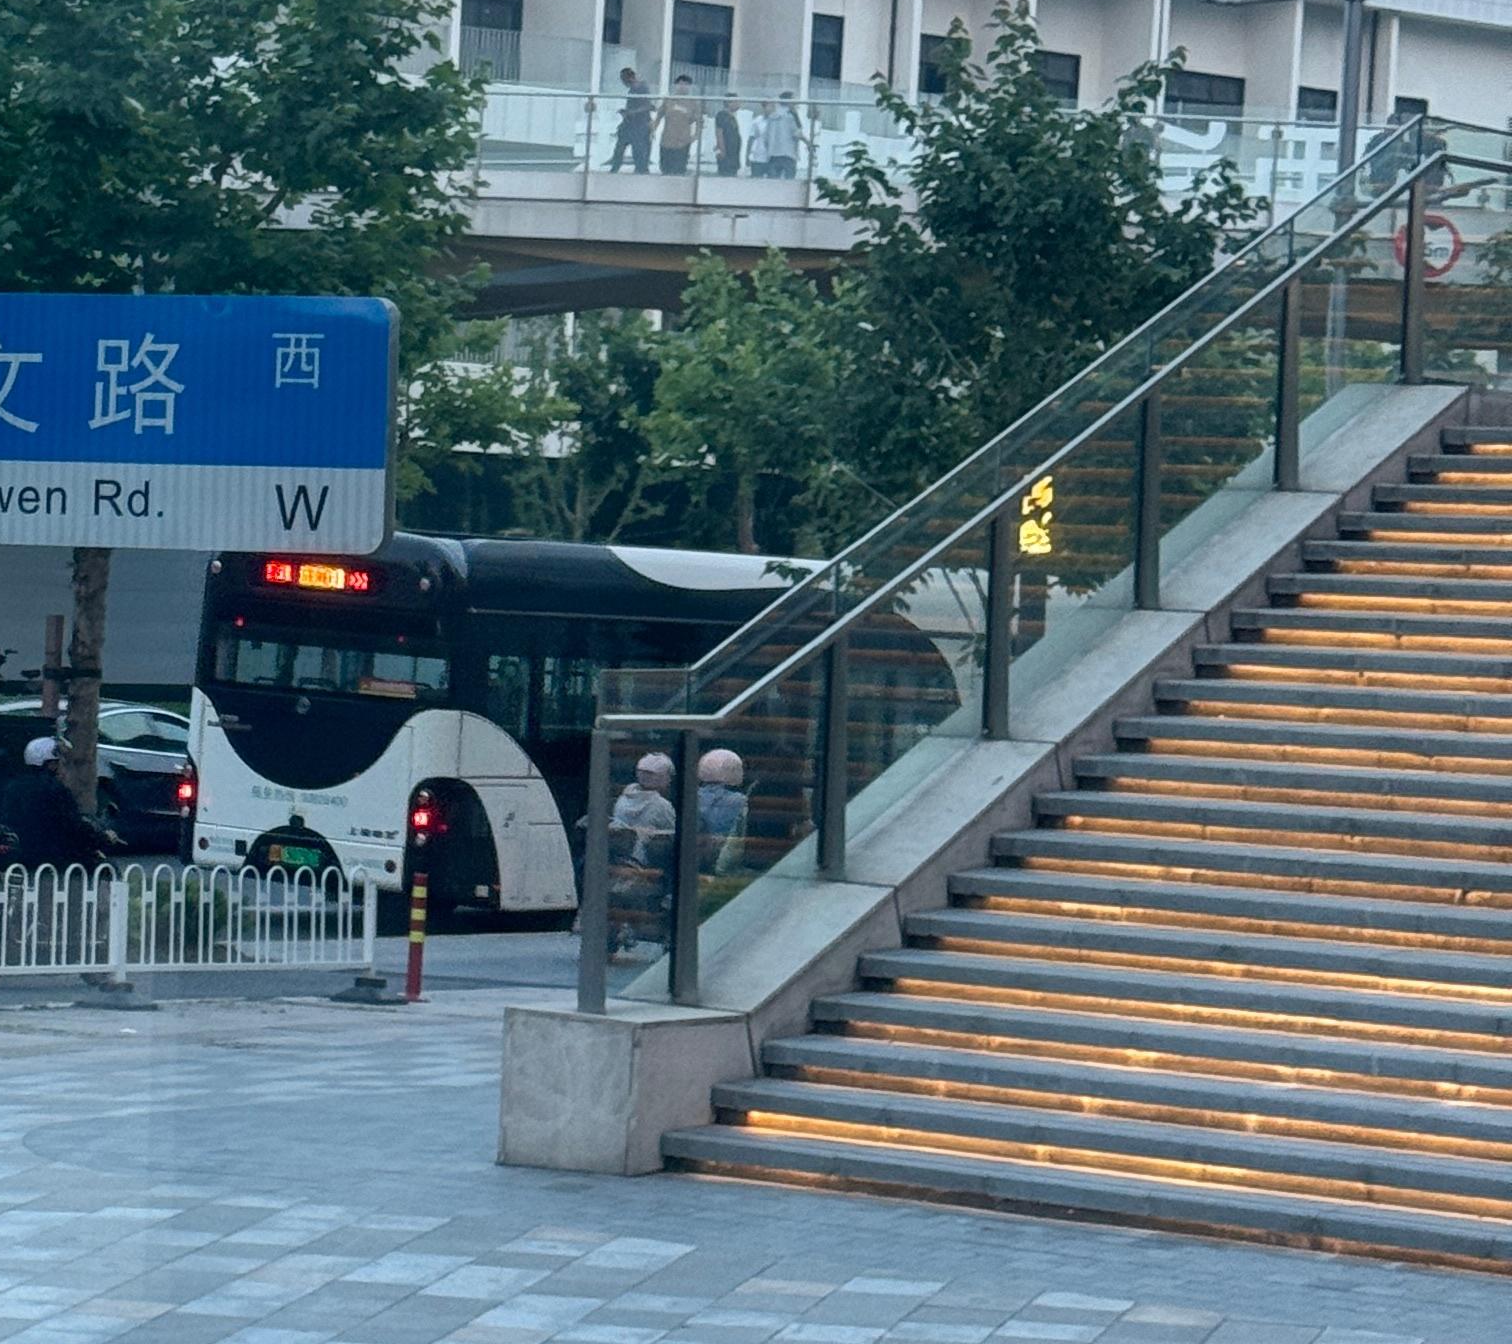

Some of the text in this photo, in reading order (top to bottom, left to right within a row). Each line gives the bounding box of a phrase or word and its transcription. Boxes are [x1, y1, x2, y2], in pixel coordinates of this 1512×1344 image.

[272, 332, 325, 389] 西
[93, 479, 164, 518] Rd.
[275, 484, 329, 532] W
